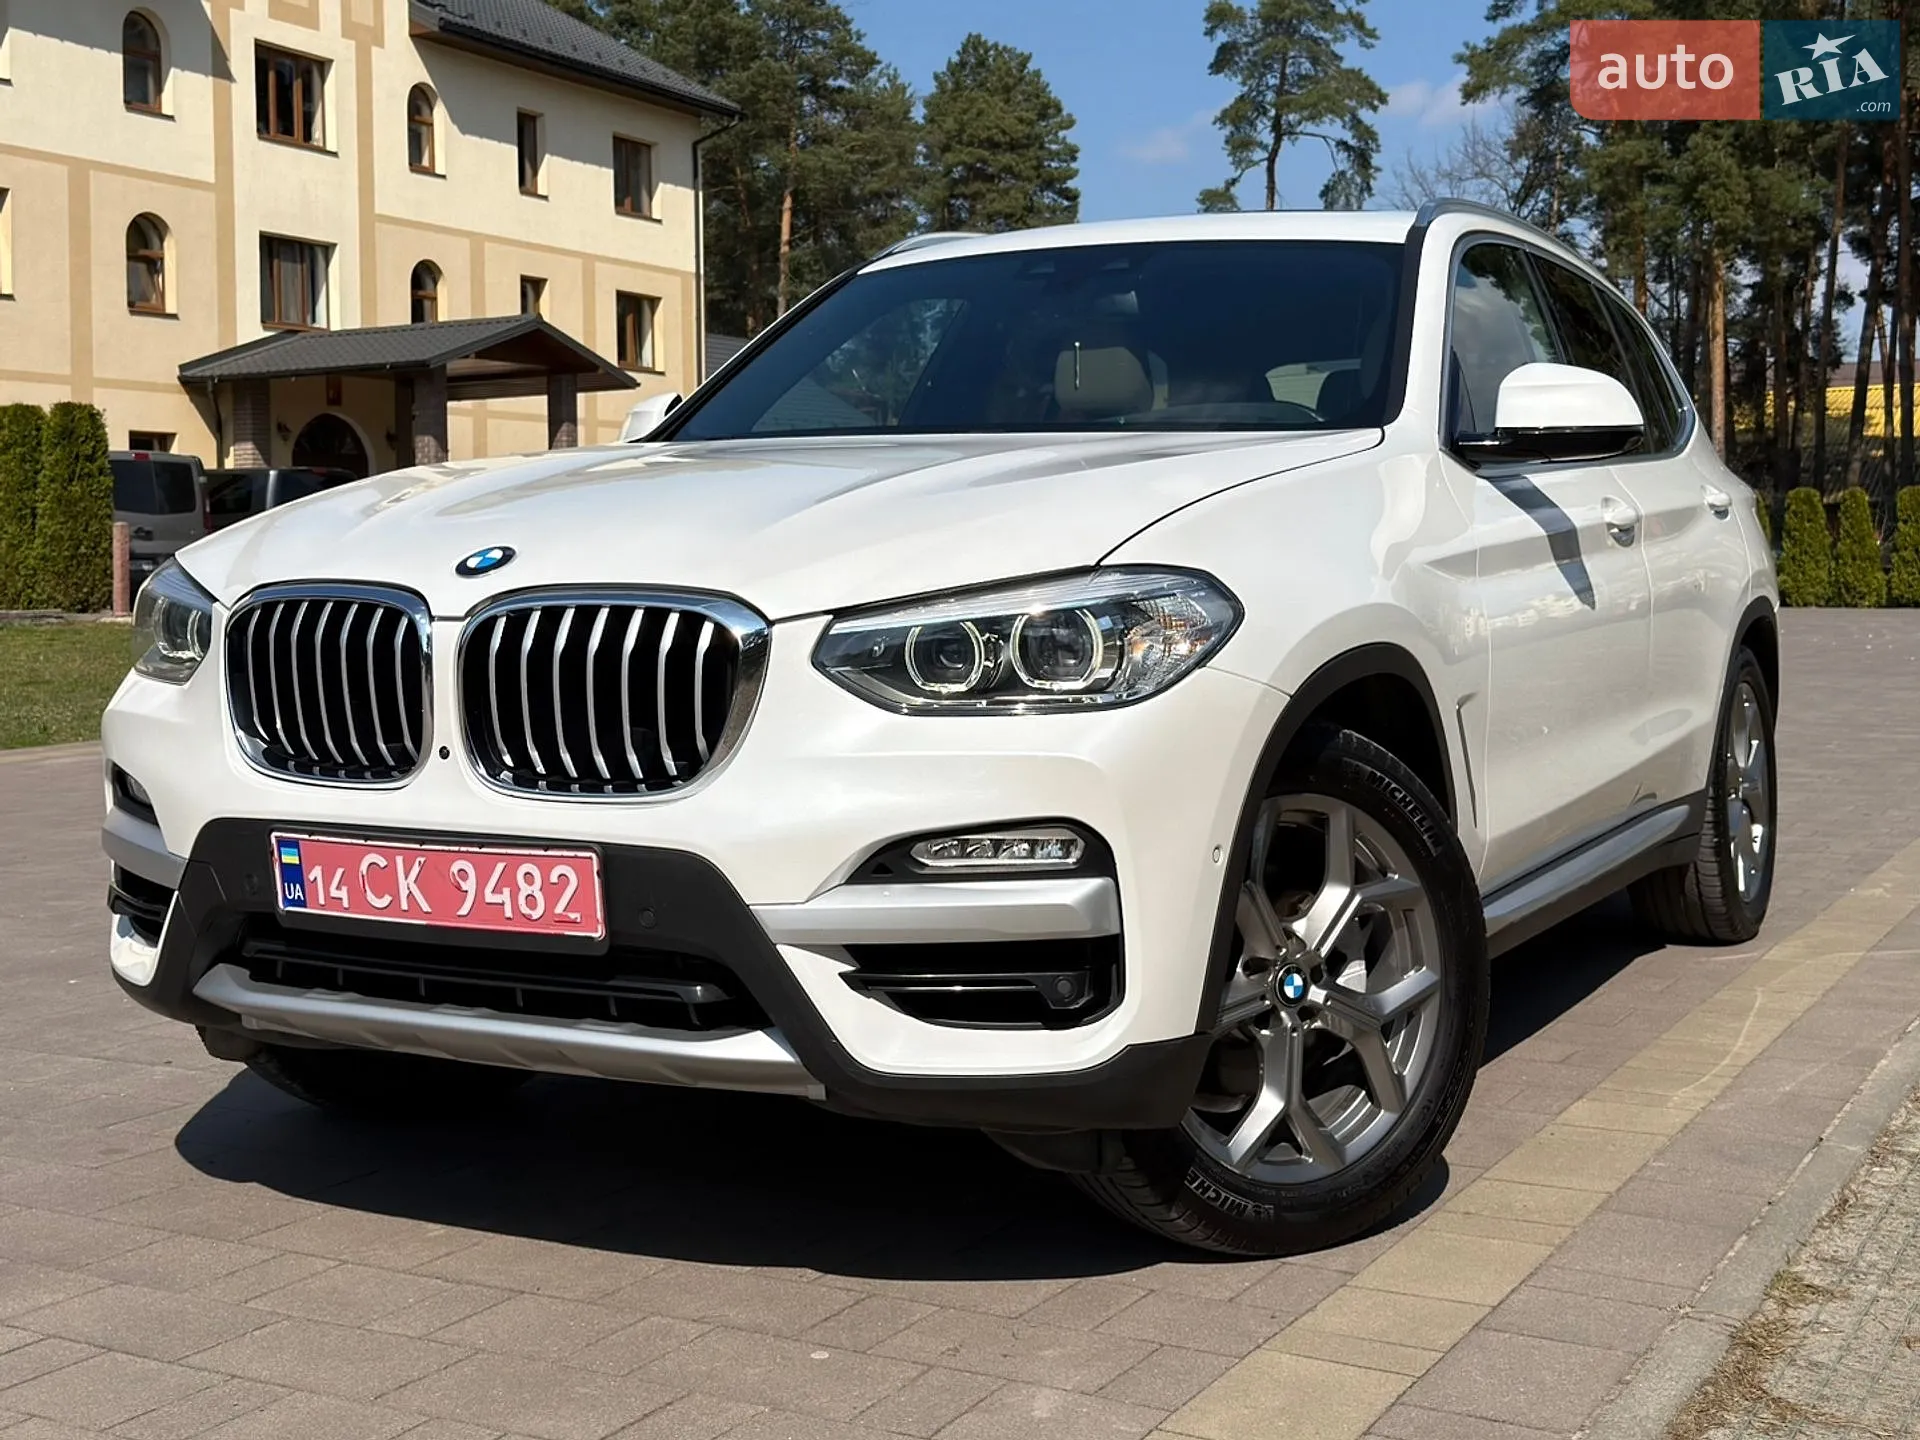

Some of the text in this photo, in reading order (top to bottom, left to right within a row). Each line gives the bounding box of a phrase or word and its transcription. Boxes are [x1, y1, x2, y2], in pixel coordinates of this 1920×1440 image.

[1366, 770, 1442, 849] MICHELIN
[284, 882, 304, 901] UA
[308, 853, 583, 923] 14 CK 9482
